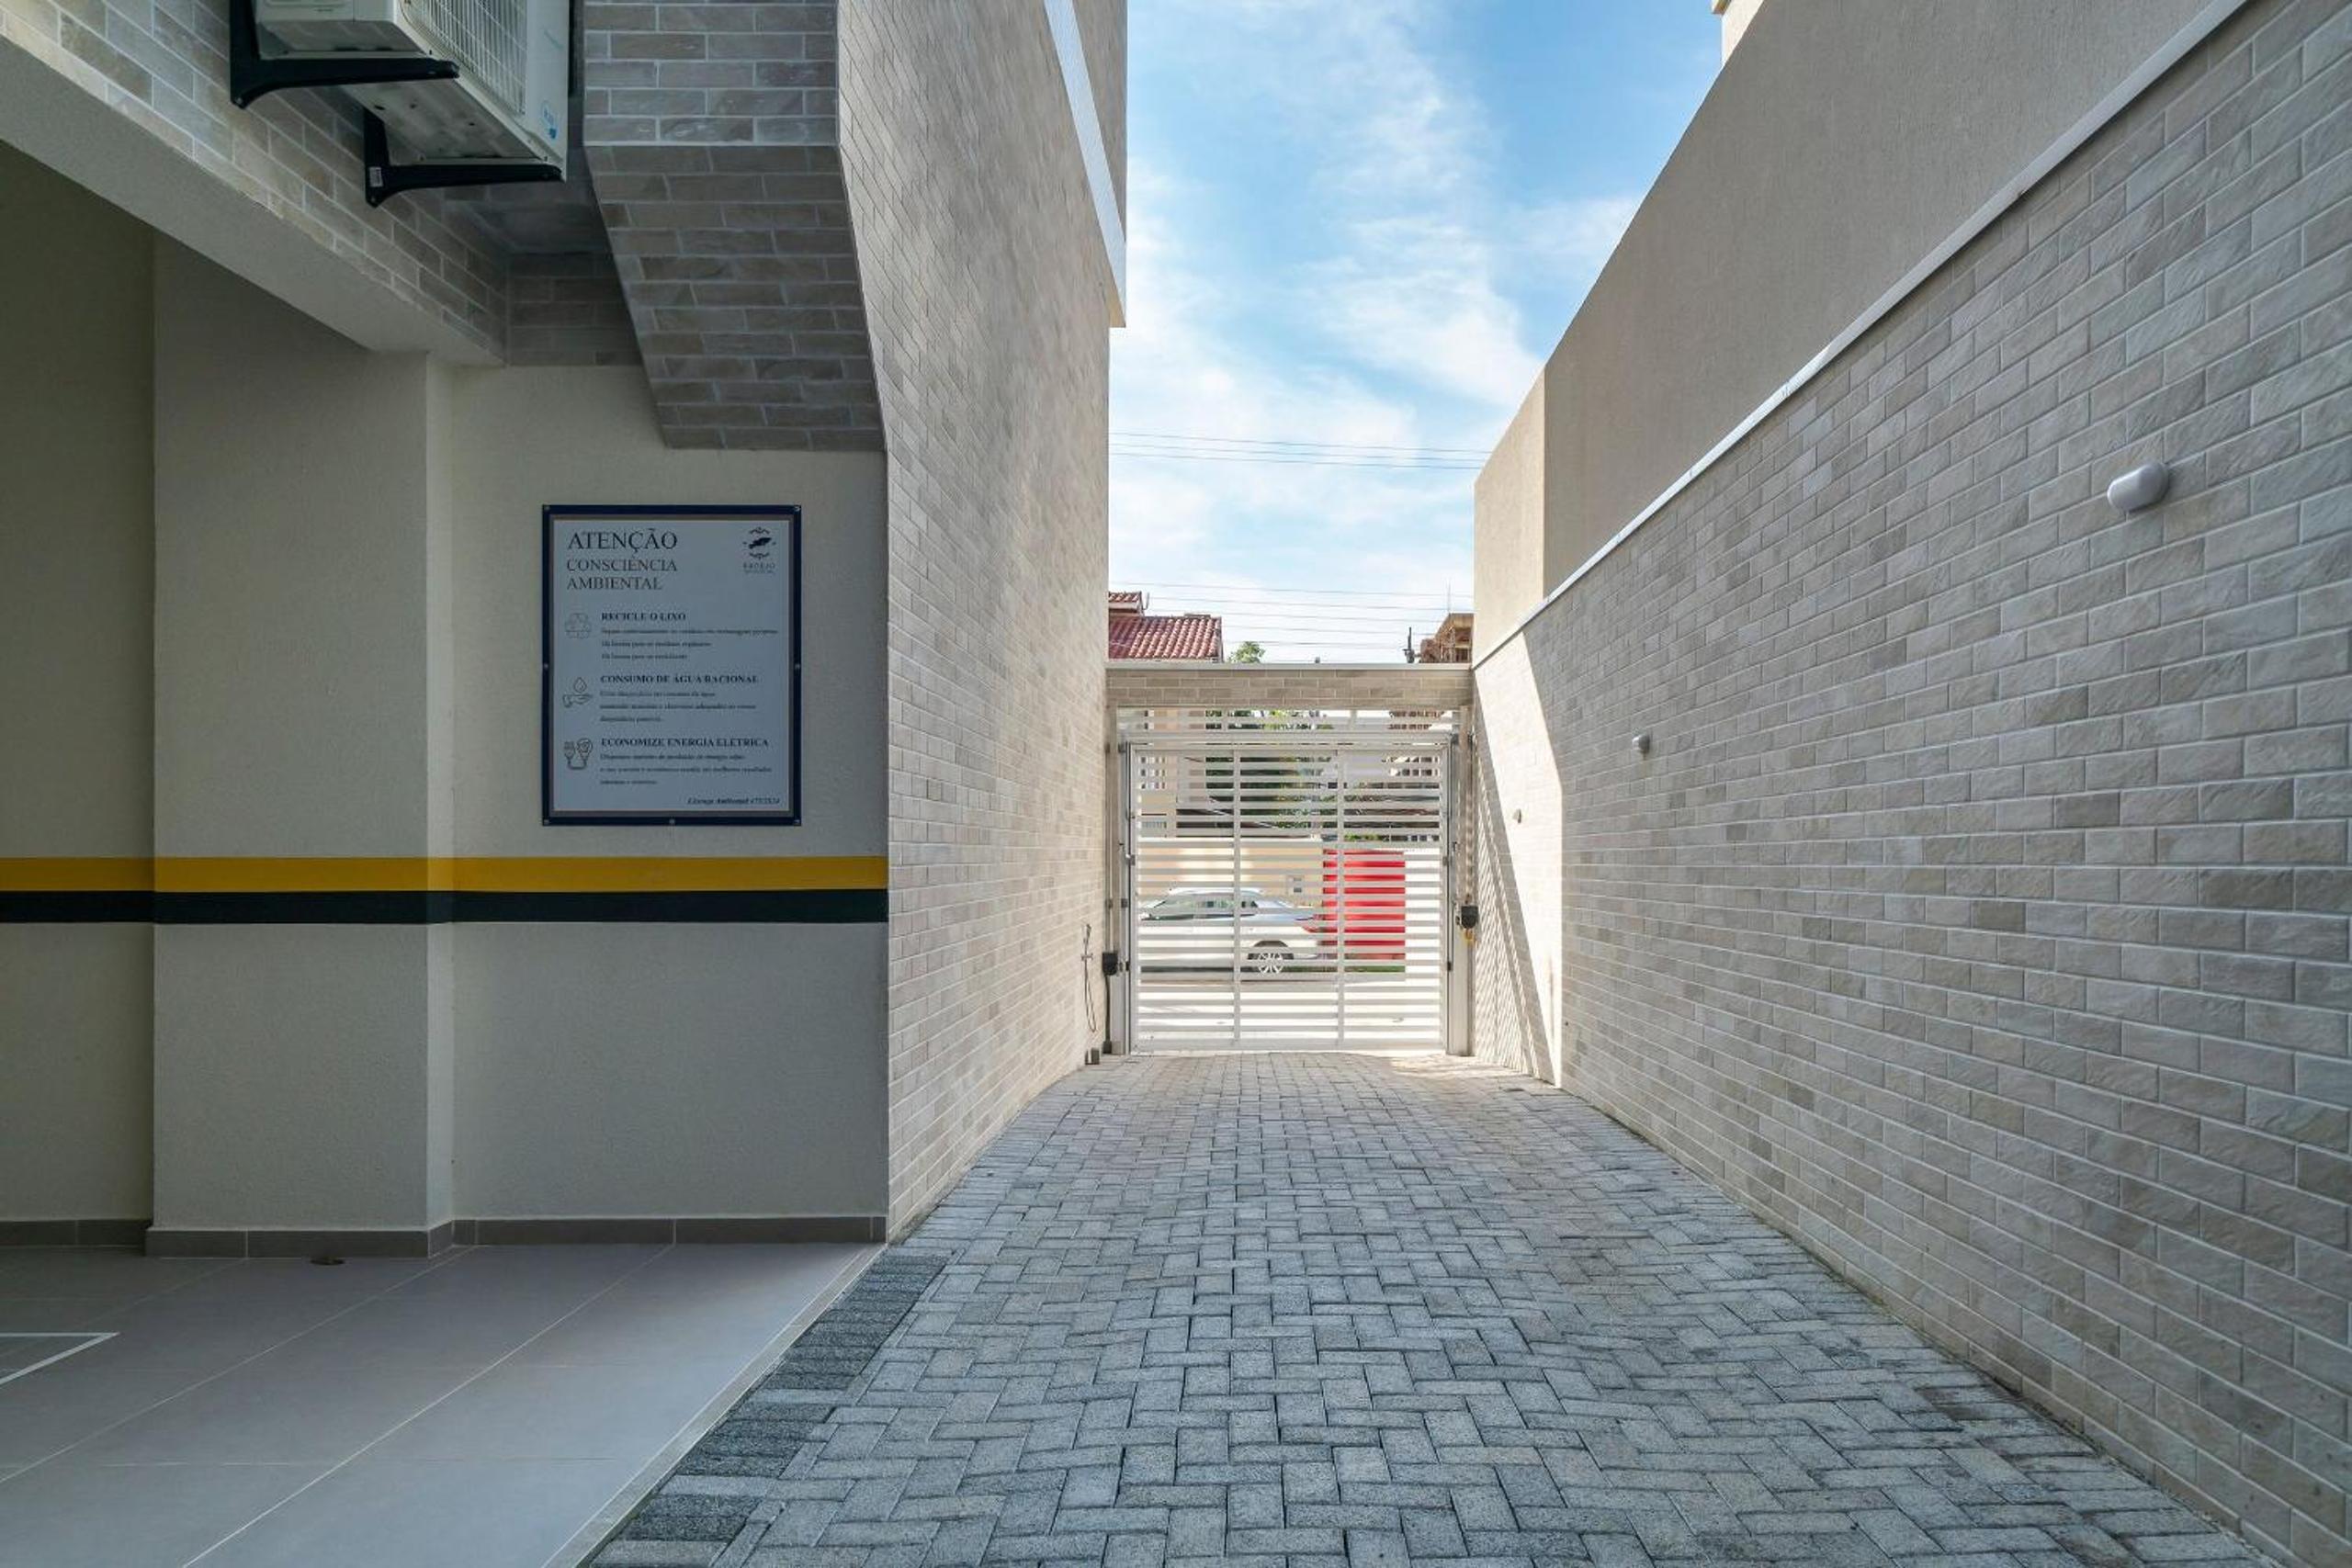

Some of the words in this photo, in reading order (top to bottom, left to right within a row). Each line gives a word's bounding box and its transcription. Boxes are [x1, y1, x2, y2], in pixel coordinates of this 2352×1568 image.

[567, 528, 678, 553] ATENÇÃO
[566, 556, 678, 572] CONSCIÊNCIA
[566, 577, 662, 591] AMBIENTAL
[602, 612, 647, 621] RECICLE
[650, 612, 658, 621] O
[659, 612, 686, 621] LIXO
[600, 674, 653, 683] CONSUMO
[656, 674, 670, 683] DE
[704, 674, 758, 683] RACIONAL
[601, 738, 663, 747] ECONOMIZE
